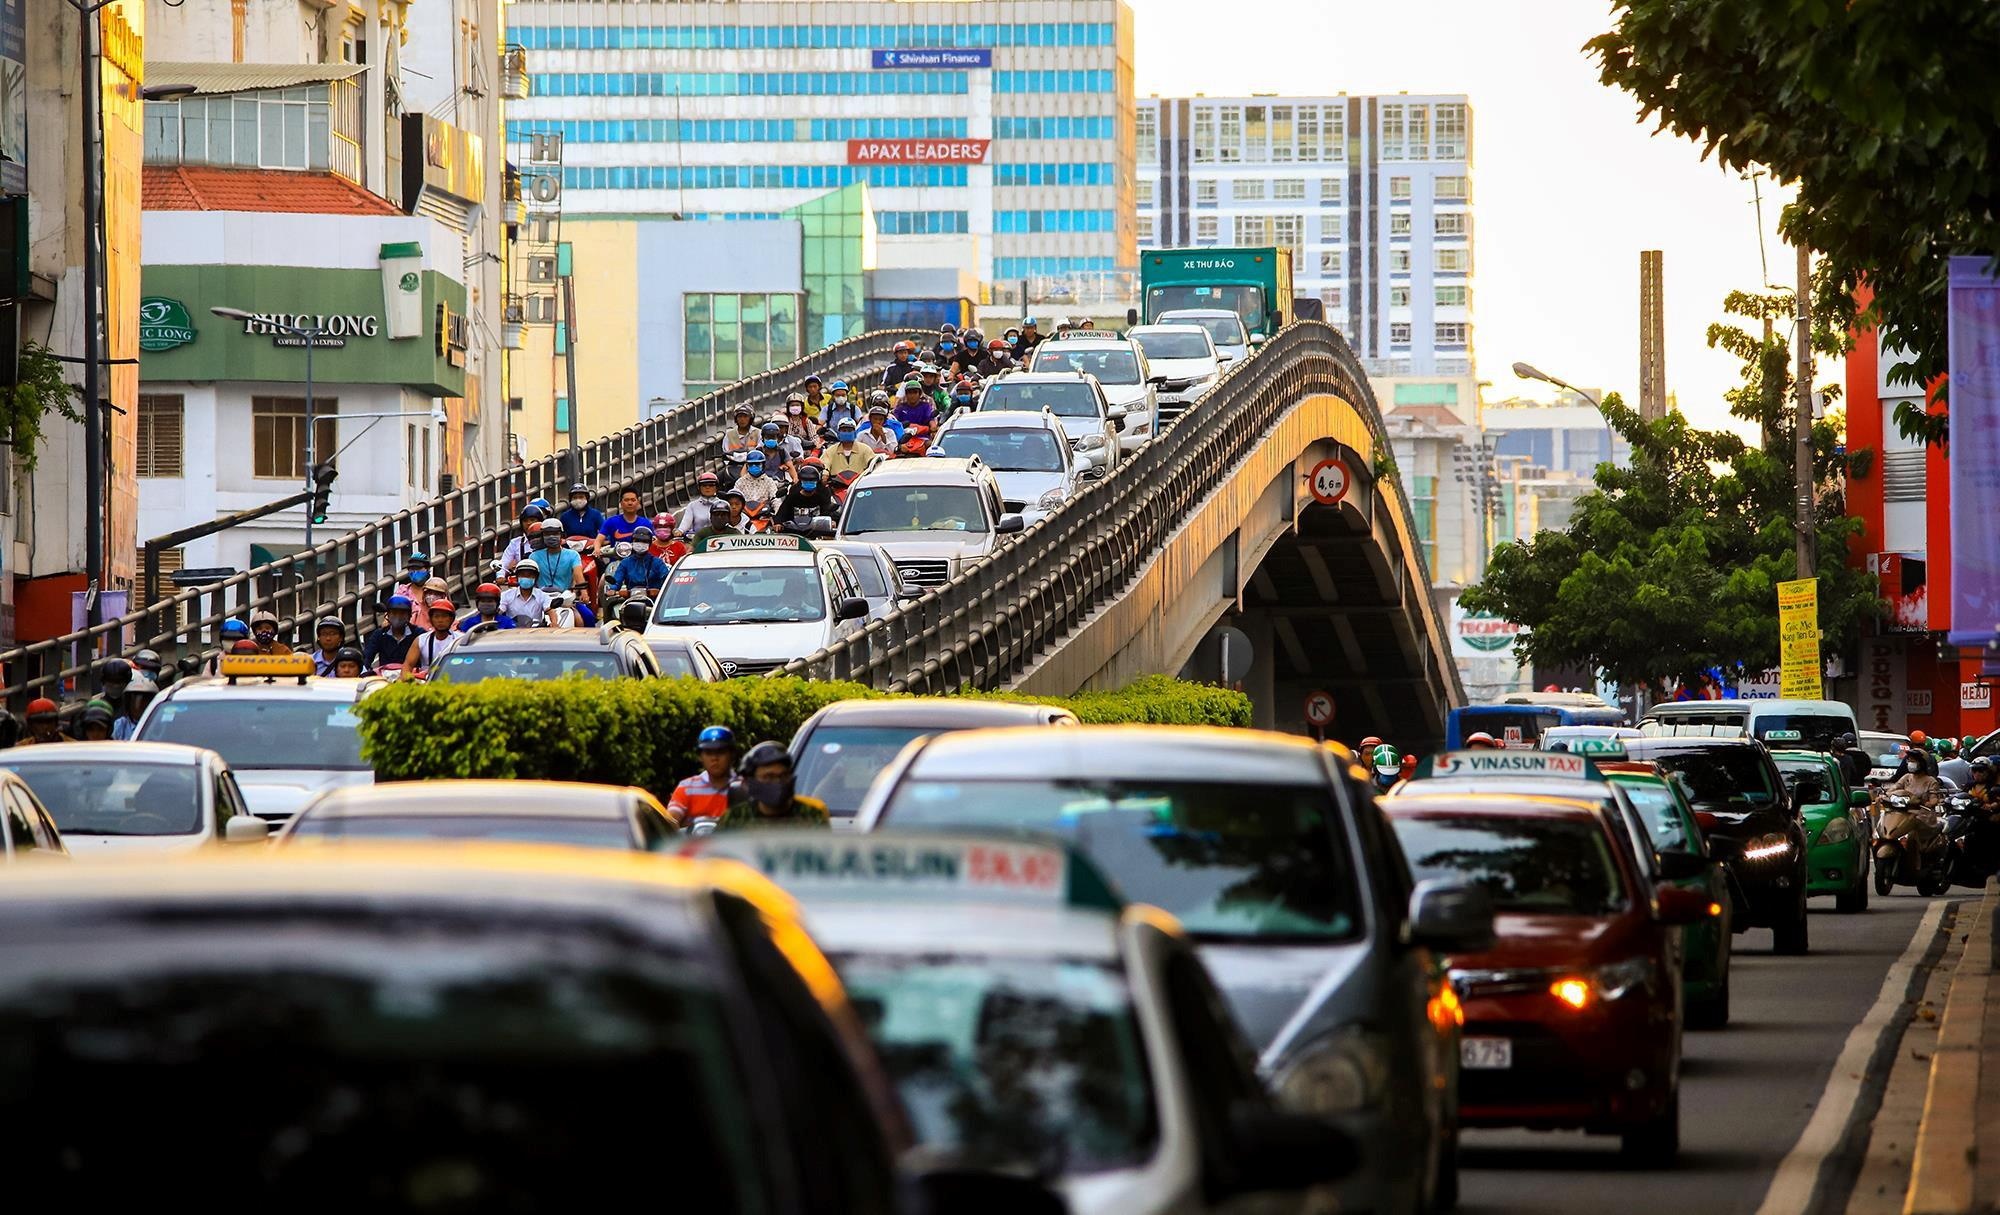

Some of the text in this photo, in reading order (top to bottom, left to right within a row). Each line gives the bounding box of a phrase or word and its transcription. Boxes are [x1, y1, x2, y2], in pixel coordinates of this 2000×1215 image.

[899, 52, 981, 64] Shinhan Finance
[857, 143, 982, 159] APAX LEADERS
[1183, 260, 1195, 269] XE
[315, 314, 379, 337] LONG
[158, 328, 192, 340] LONG
[1101, 331, 1115, 339] TAXI
[730, 538, 797, 547] VINASUN TAXI
[1906, 692, 1931, 706] HEAD
[1962, 686, 1989, 700] HEAD
[1505, 728, 1520, 741] 104
[1768, 730, 1799, 739] TAXI
[1470, 756, 1582, 772] VINASUN TAXI
